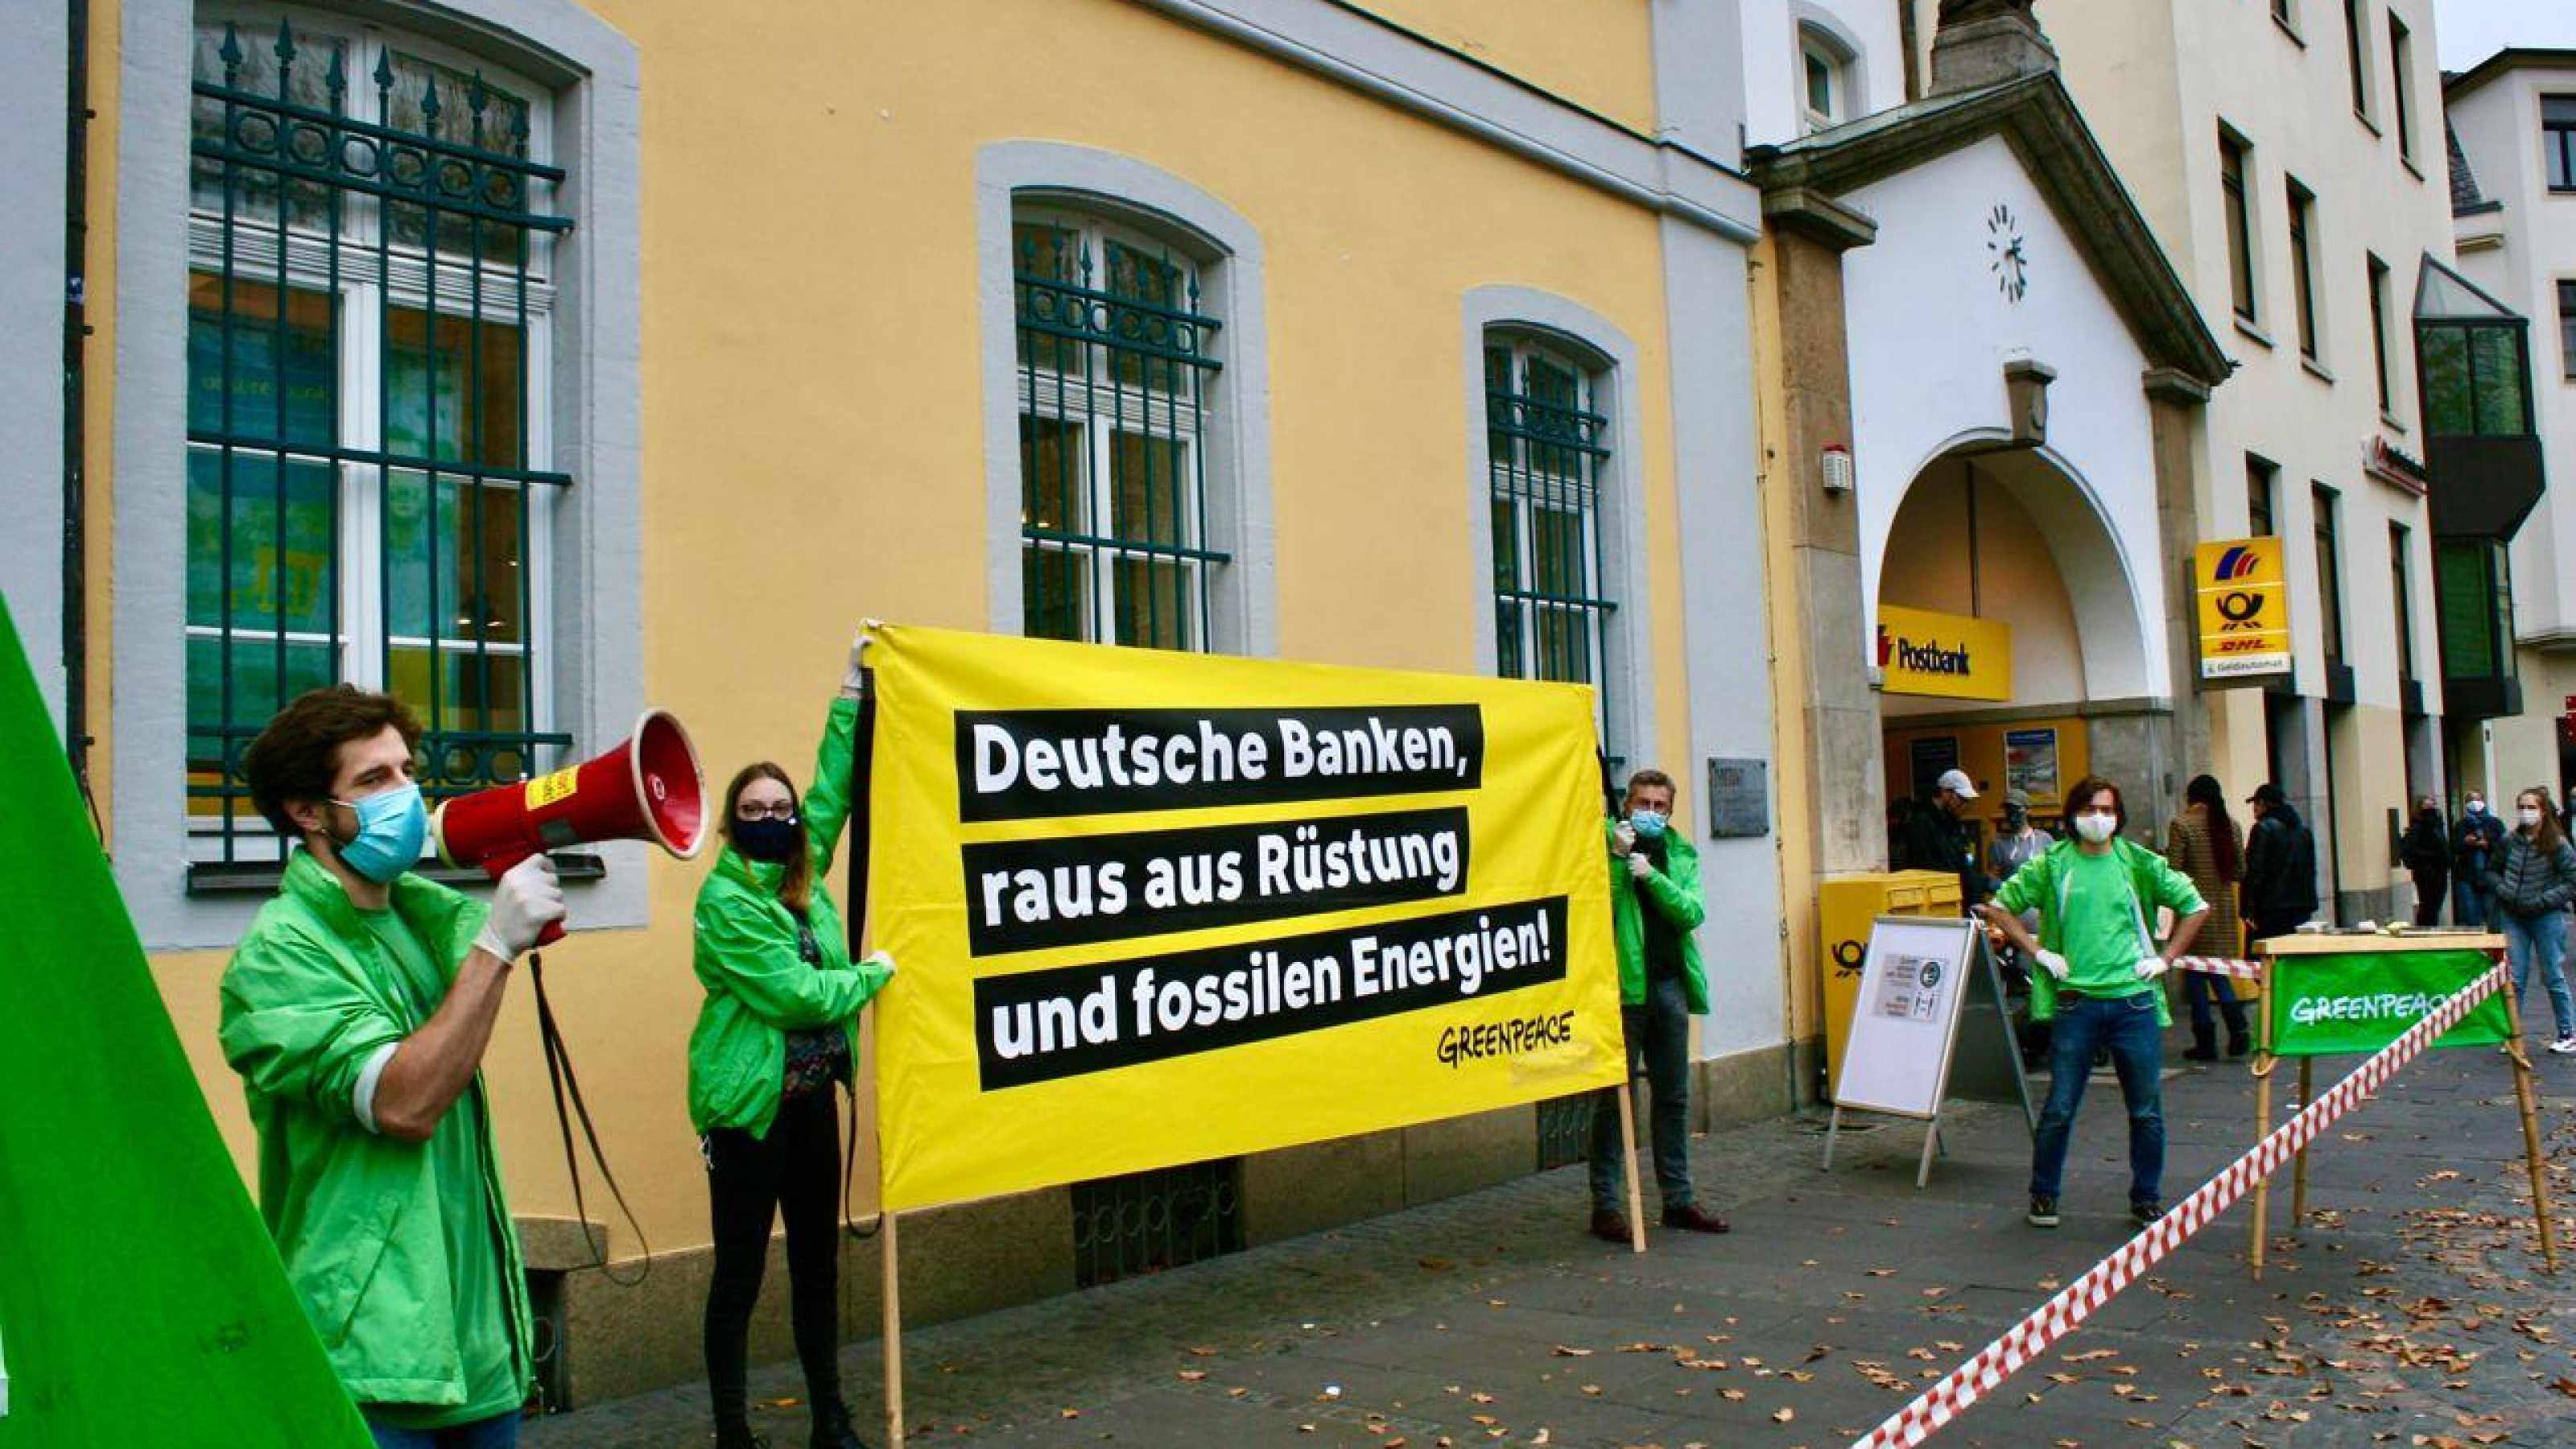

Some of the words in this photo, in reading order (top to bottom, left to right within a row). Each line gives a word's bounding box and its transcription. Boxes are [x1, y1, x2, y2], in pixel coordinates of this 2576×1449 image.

[1898, 637, 1969, 676] Postbank
[2219, 639, 2267, 651] DHL
[973, 719, 1269, 795] Deutsche
[1277, 716, 1468, 778] Banken,
[980, 860, 1129, 927] raus
[1143, 850, 1244, 910] aus
[1257, 824, 1460, 897] Rüstung
[993, 974, 1119, 1060] und
[1131, 950, 1342, 1037] fossilen
[1350, 909, 1551, 997] Energien!
[2289, 992, 2449, 1027] GREENPEAC
[1436, 1009, 1575, 1069] GREENPEACE
